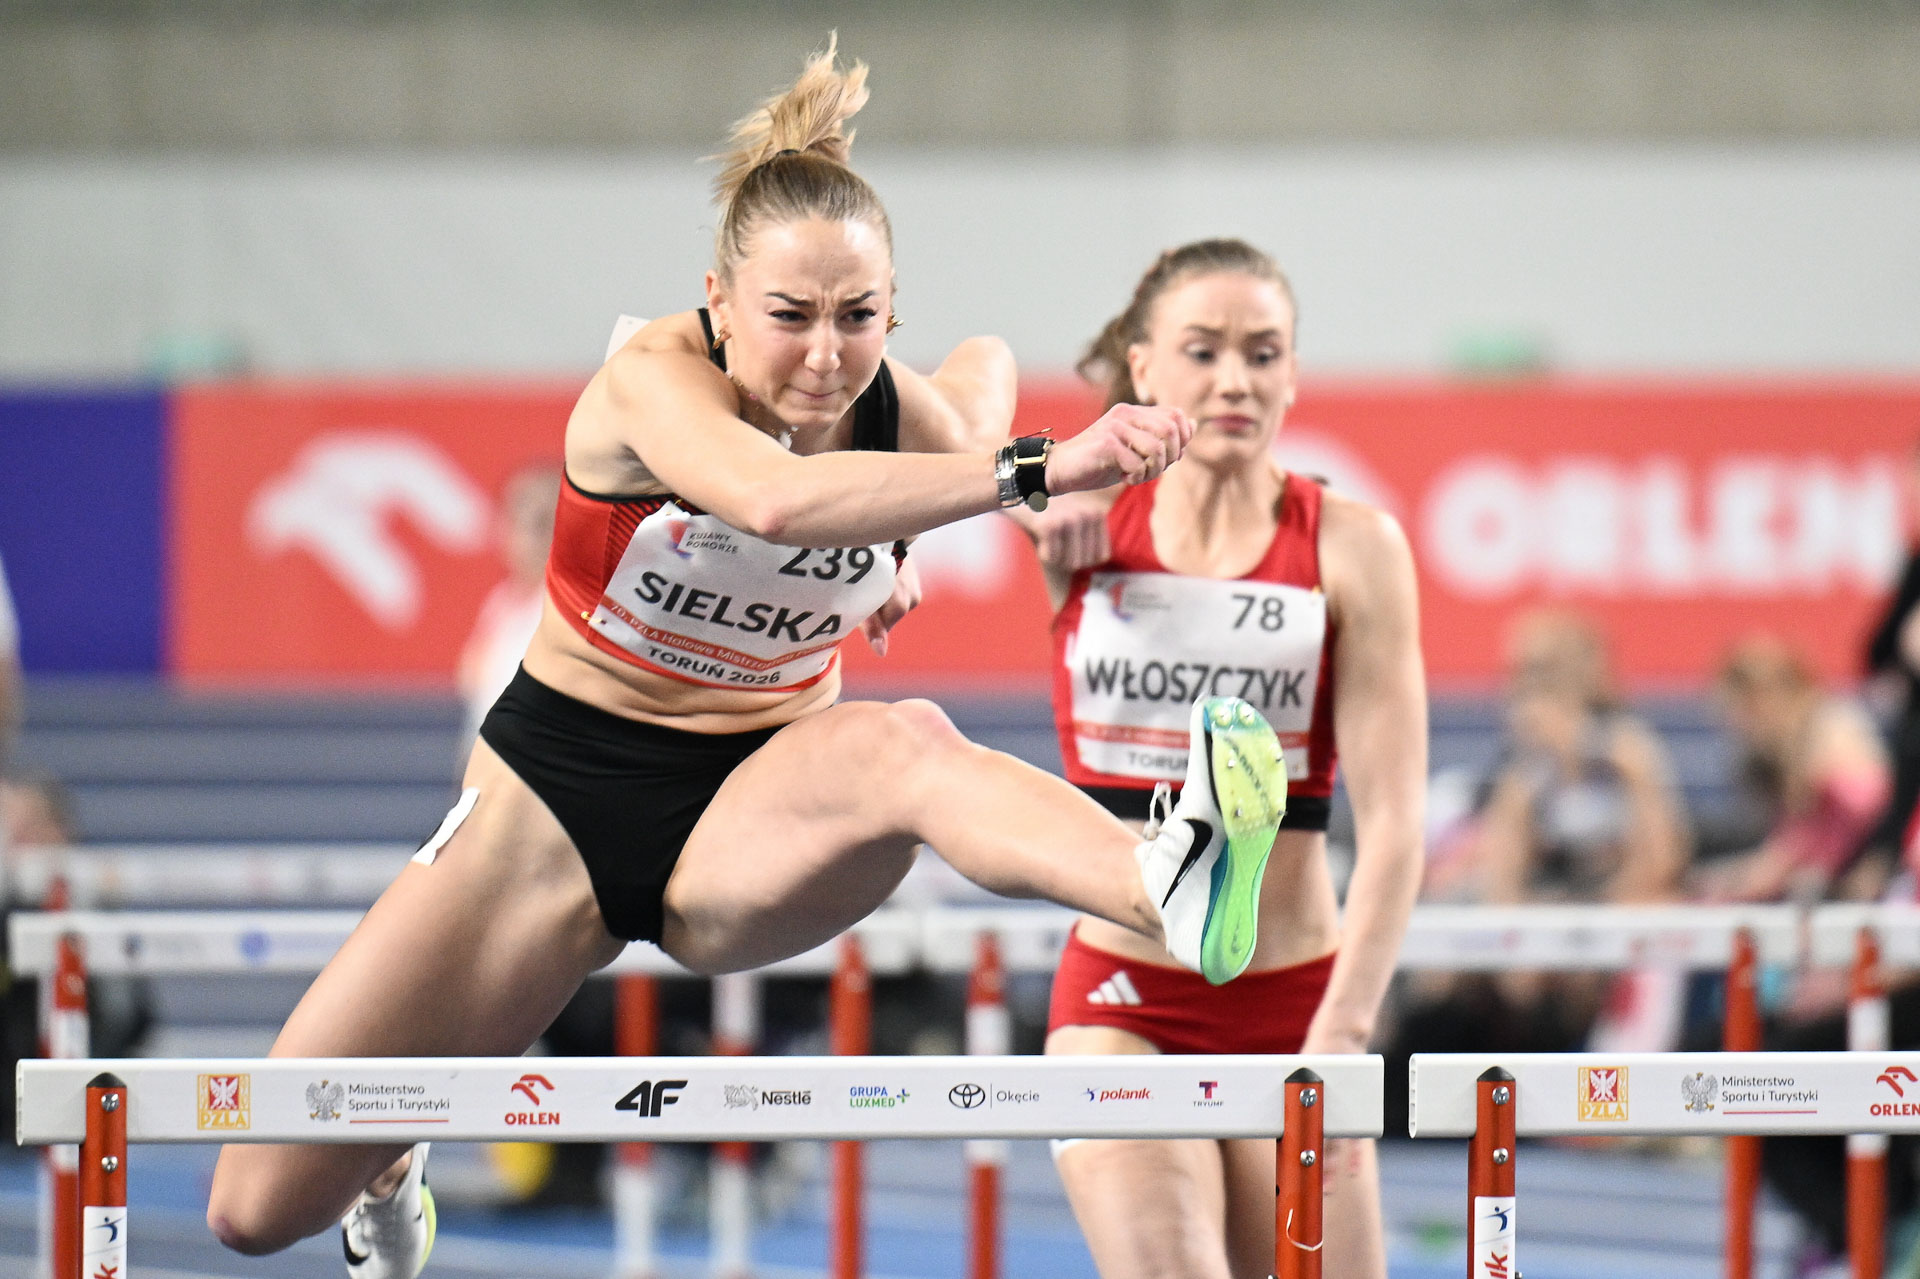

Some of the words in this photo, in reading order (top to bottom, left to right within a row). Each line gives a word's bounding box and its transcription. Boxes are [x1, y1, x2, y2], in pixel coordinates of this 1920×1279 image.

[689, 531, 731, 542] KUJAWY
[686, 540, 738, 554] POMORZE
[779, 546, 875, 585] 239
[633, 571, 842, 643] SIELSKA
[1232, 593, 1284, 632] 78
[648, 646, 725, 679] TORUŃ
[727, 671, 781, 685] 2026
[1086, 657, 1305, 708] WŁOSZCZYK
[1722, 1075, 1795, 1087] Ministerstwo
[348, 1084, 425, 1095] Ministerstwo
[849, 1086, 888, 1097] GRUPA
[1099, 1087, 1151, 1102] polanik
[1721, 1090, 1759, 1103] Sportu
[1769, 1090, 1818, 1103] Turystyki
[348, 1099, 388, 1112] Sportu
[398, 1098, 450, 1112] Turystyki
[614, 1080, 688, 1117] 4F
[849, 1097, 896, 1108] LUXMED
[996, 1090, 1040, 1105] Okęcie
[1581, 1103, 1625, 1119] PZLA
[200, 1111, 248, 1128] PZLA
[504, 1113, 560, 1125] ORLEN
